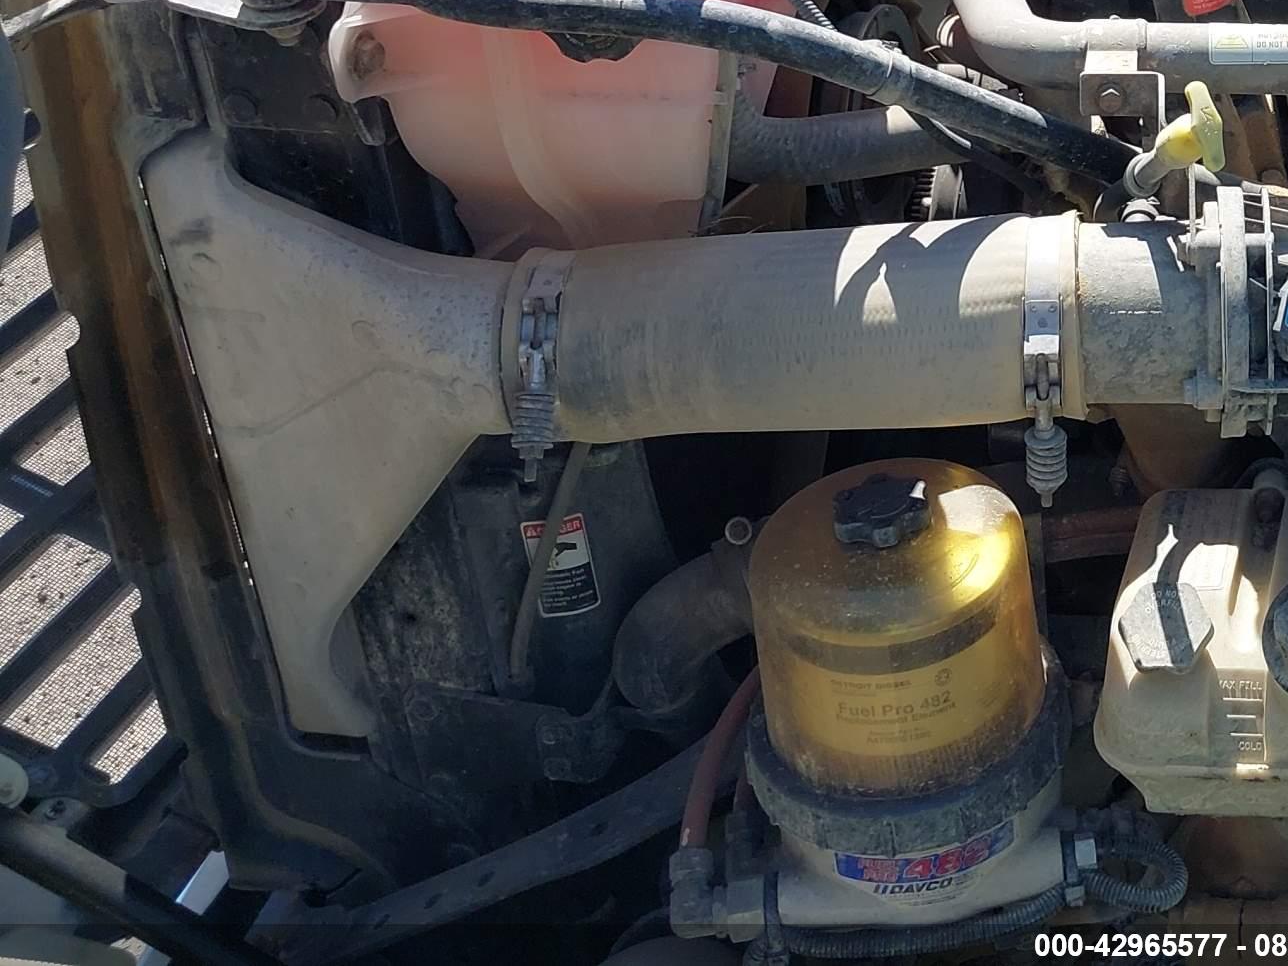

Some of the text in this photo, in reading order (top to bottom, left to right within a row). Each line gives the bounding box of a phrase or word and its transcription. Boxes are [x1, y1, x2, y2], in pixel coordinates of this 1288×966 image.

[1256, 41, 1267, 49] DO
[1270, 41, 1284, 49] NOT
[1239, 680, 1263, 691] FILL
[838, 690, 952, 718] Fuel Pro 482
[1238, 740, 1263, 751] COLD
[902, 834, 993, 879] 482
[889, 877, 954, 895] DAVCO
